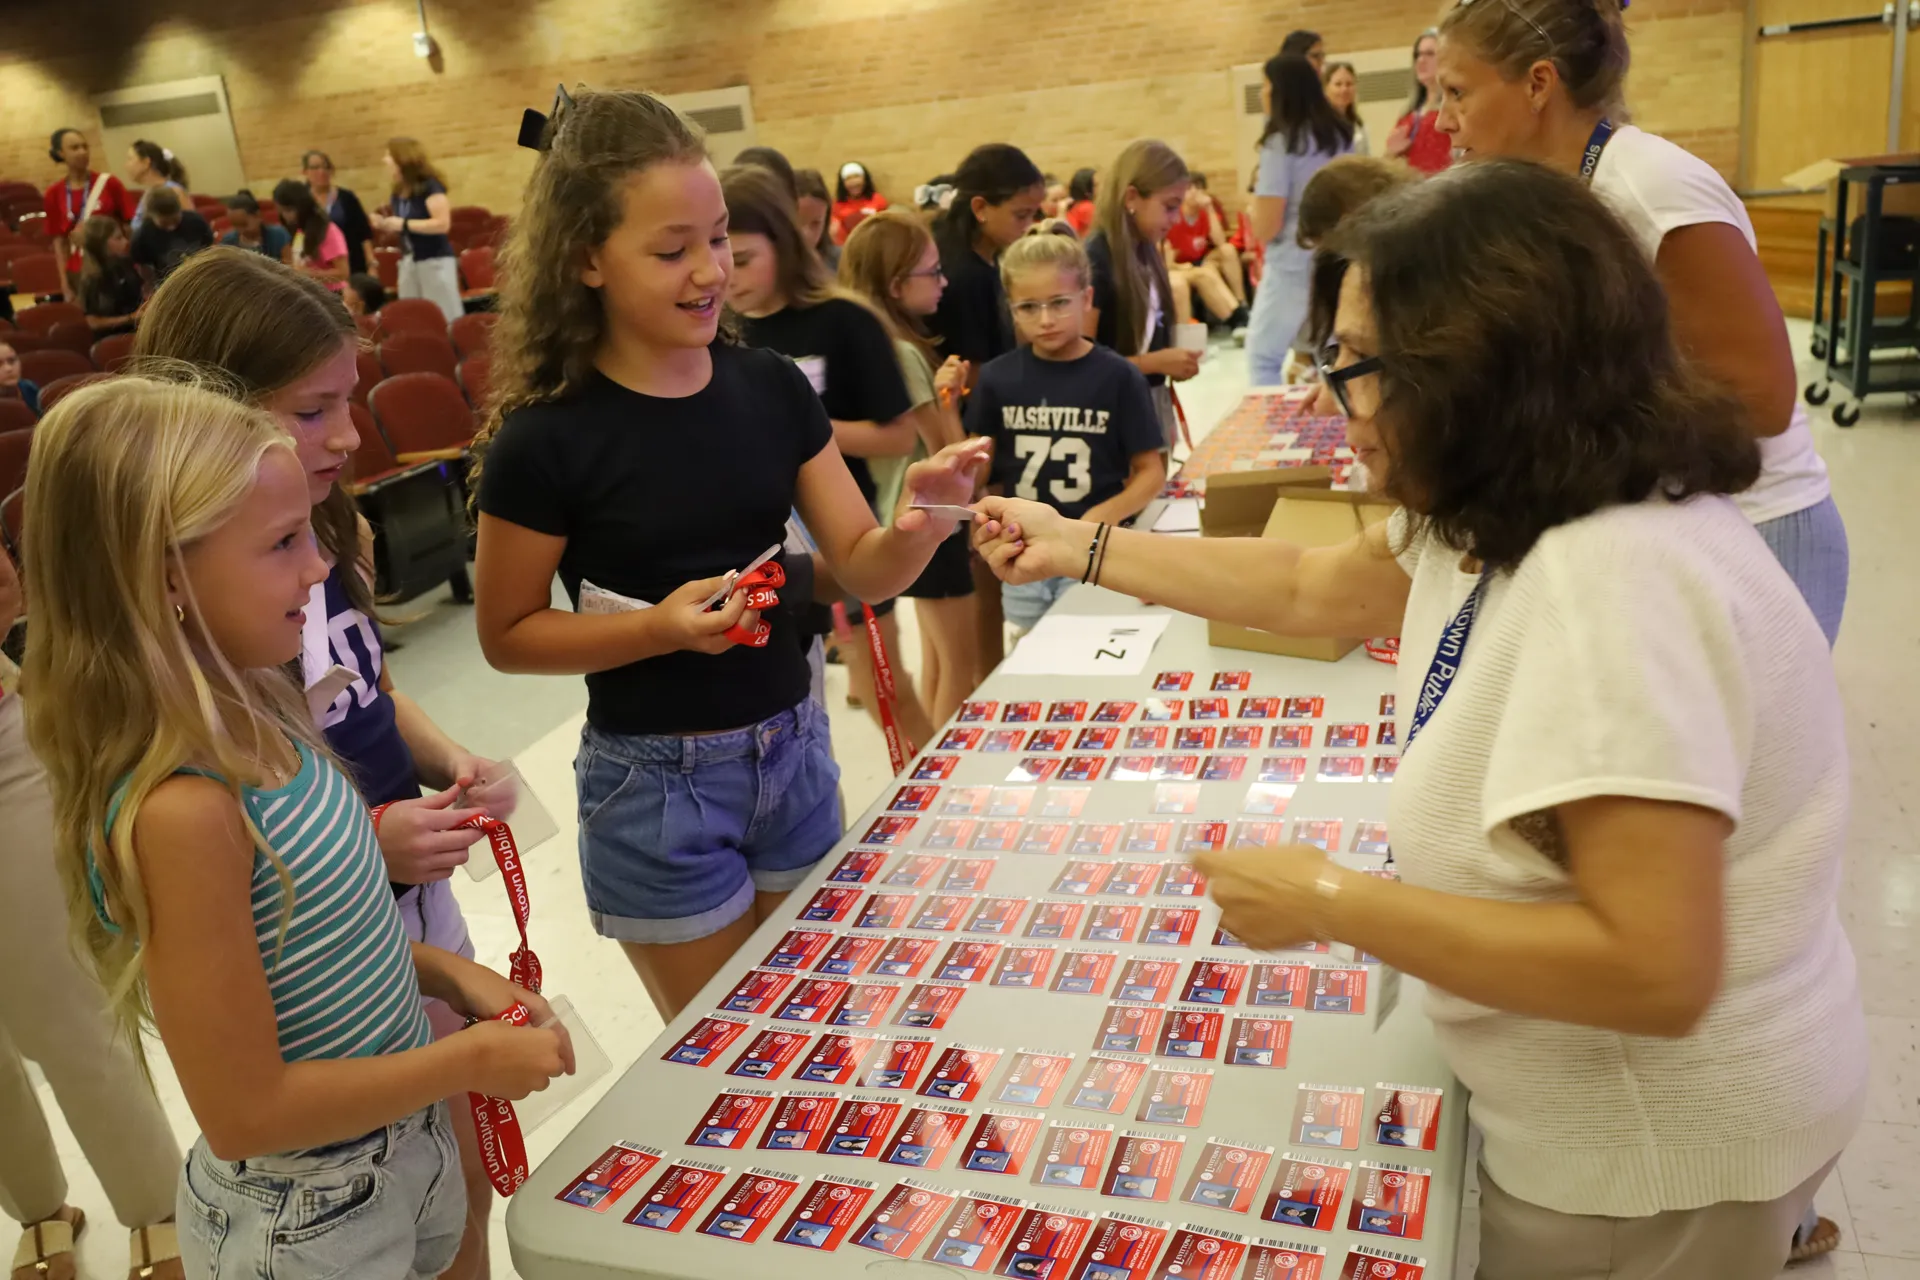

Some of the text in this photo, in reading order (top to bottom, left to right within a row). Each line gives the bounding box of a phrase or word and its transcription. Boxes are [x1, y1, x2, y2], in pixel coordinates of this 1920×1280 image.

[1002, 405, 1110, 434] NASHVILLE
[1015, 434, 1091, 503] 73
[1418, 660, 1458, 718] Public
[494, 824, 518, 872] Public
[475, 1101, 500, 1174] Levittown
[592, 1148, 623, 1174] LEVITTOWN
[656, 1167, 683, 1194] LEVITTOWN
[729, 1175, 755, 1203] LEVITTOWN
[752, 1200, 770, 1217] LONDON
[804, 1183, 828, 1211] LEVITTOWN
[830, 1208, 847, 1225] COLTON
[842, 1193, 856, 1208] WOODS
[882, 1187, 909, 1215] LEVITTOWN
[951, 1200, 974, 1229] LEVITTOWN
[1020, 1212, 1041, 1242] LEVITTOWN
[1094, 1221, 1116, 1251] LEVITTOWN
[1172, 1233, 1193, 1265] LEVITTOWN
[1128, 1248, 1142, 1269] ANTHONY
[1206, 1249, 1226, 1280] LBERT ZHENG
